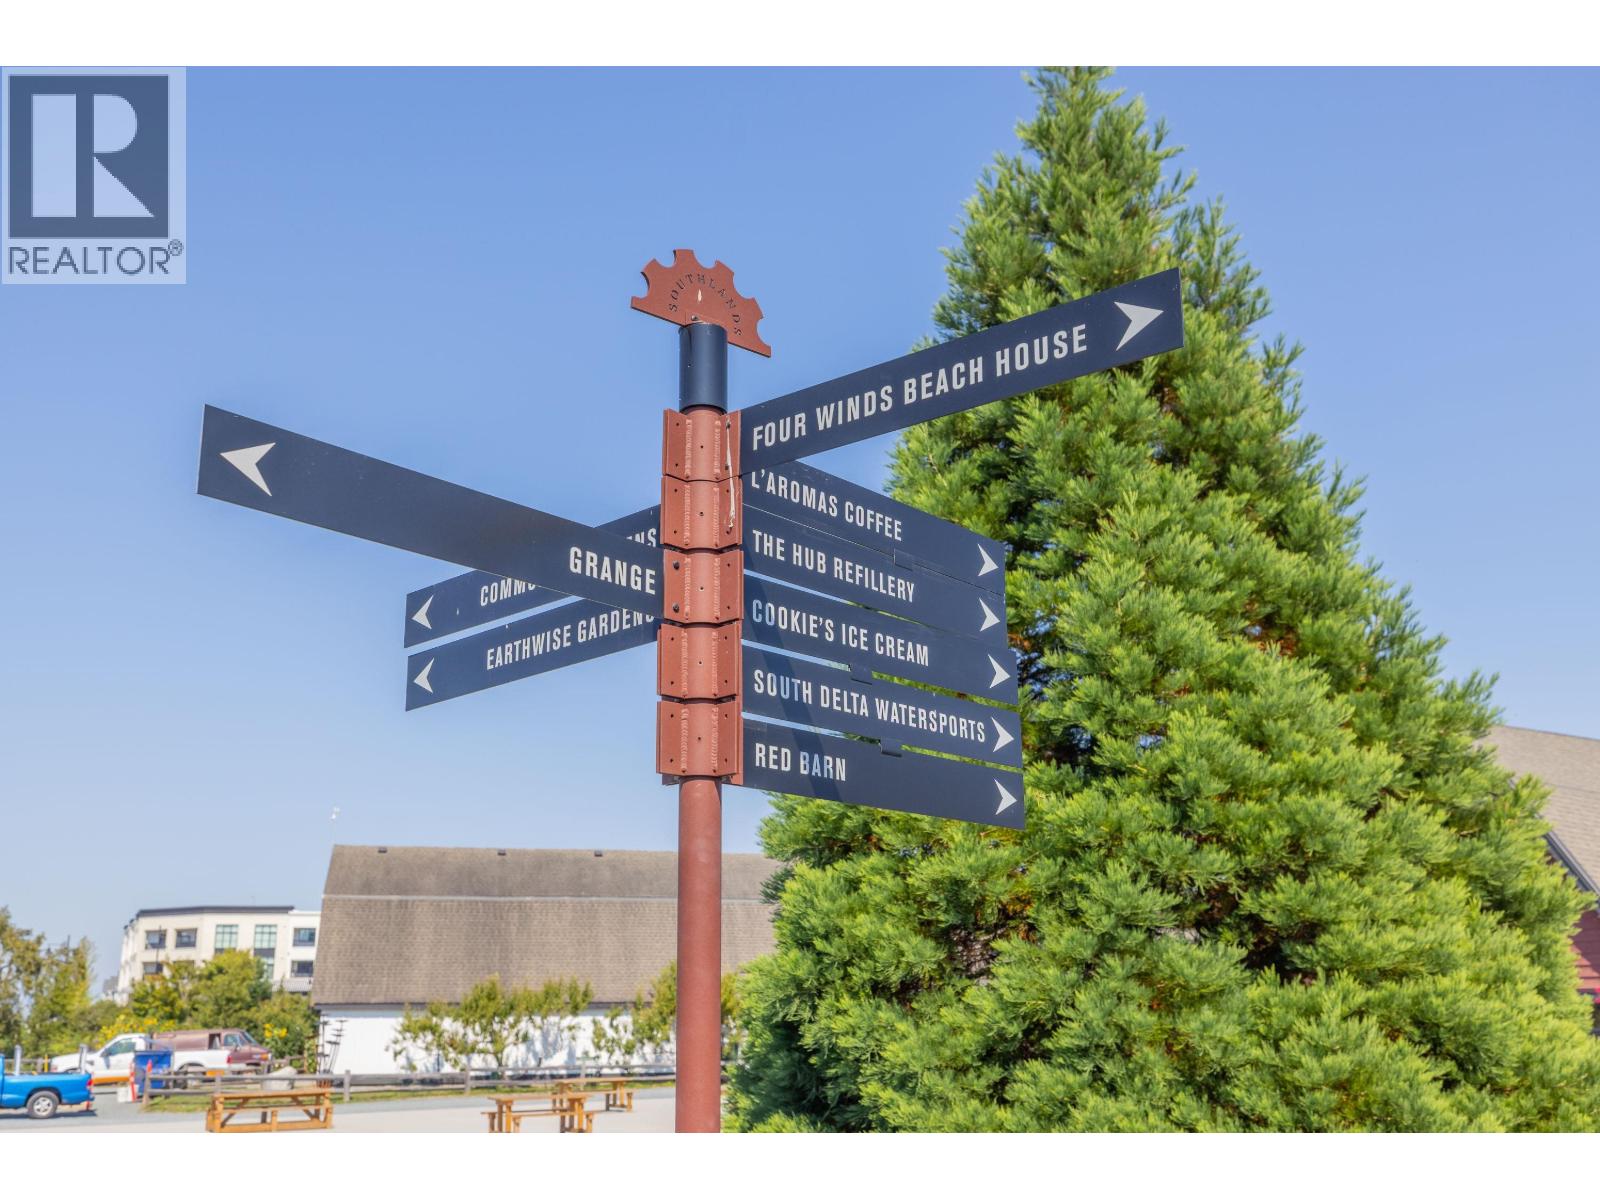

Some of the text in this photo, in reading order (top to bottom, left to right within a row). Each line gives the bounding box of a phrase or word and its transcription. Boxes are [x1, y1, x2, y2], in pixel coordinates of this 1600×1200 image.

[668, 273, 742, 336] SOUTHLANDS
[752, 323, 1087, 451] FOUR WINDS BEACH HOUSE
[844, 501, 902, 541] COFFEE
[569, 546, 656, 595] GRANGE
[752, 529, 915, 603] THE HUB REFILLERY
[486, 624, 571, 671] EARTHWISE
[752, 599, 929, 667] COOKIE'S ICE CREAM
[753, 669, 986, 743] SOUTH DELTA WATERSPORTS
[755, 742, 847, 782] RED BARN
